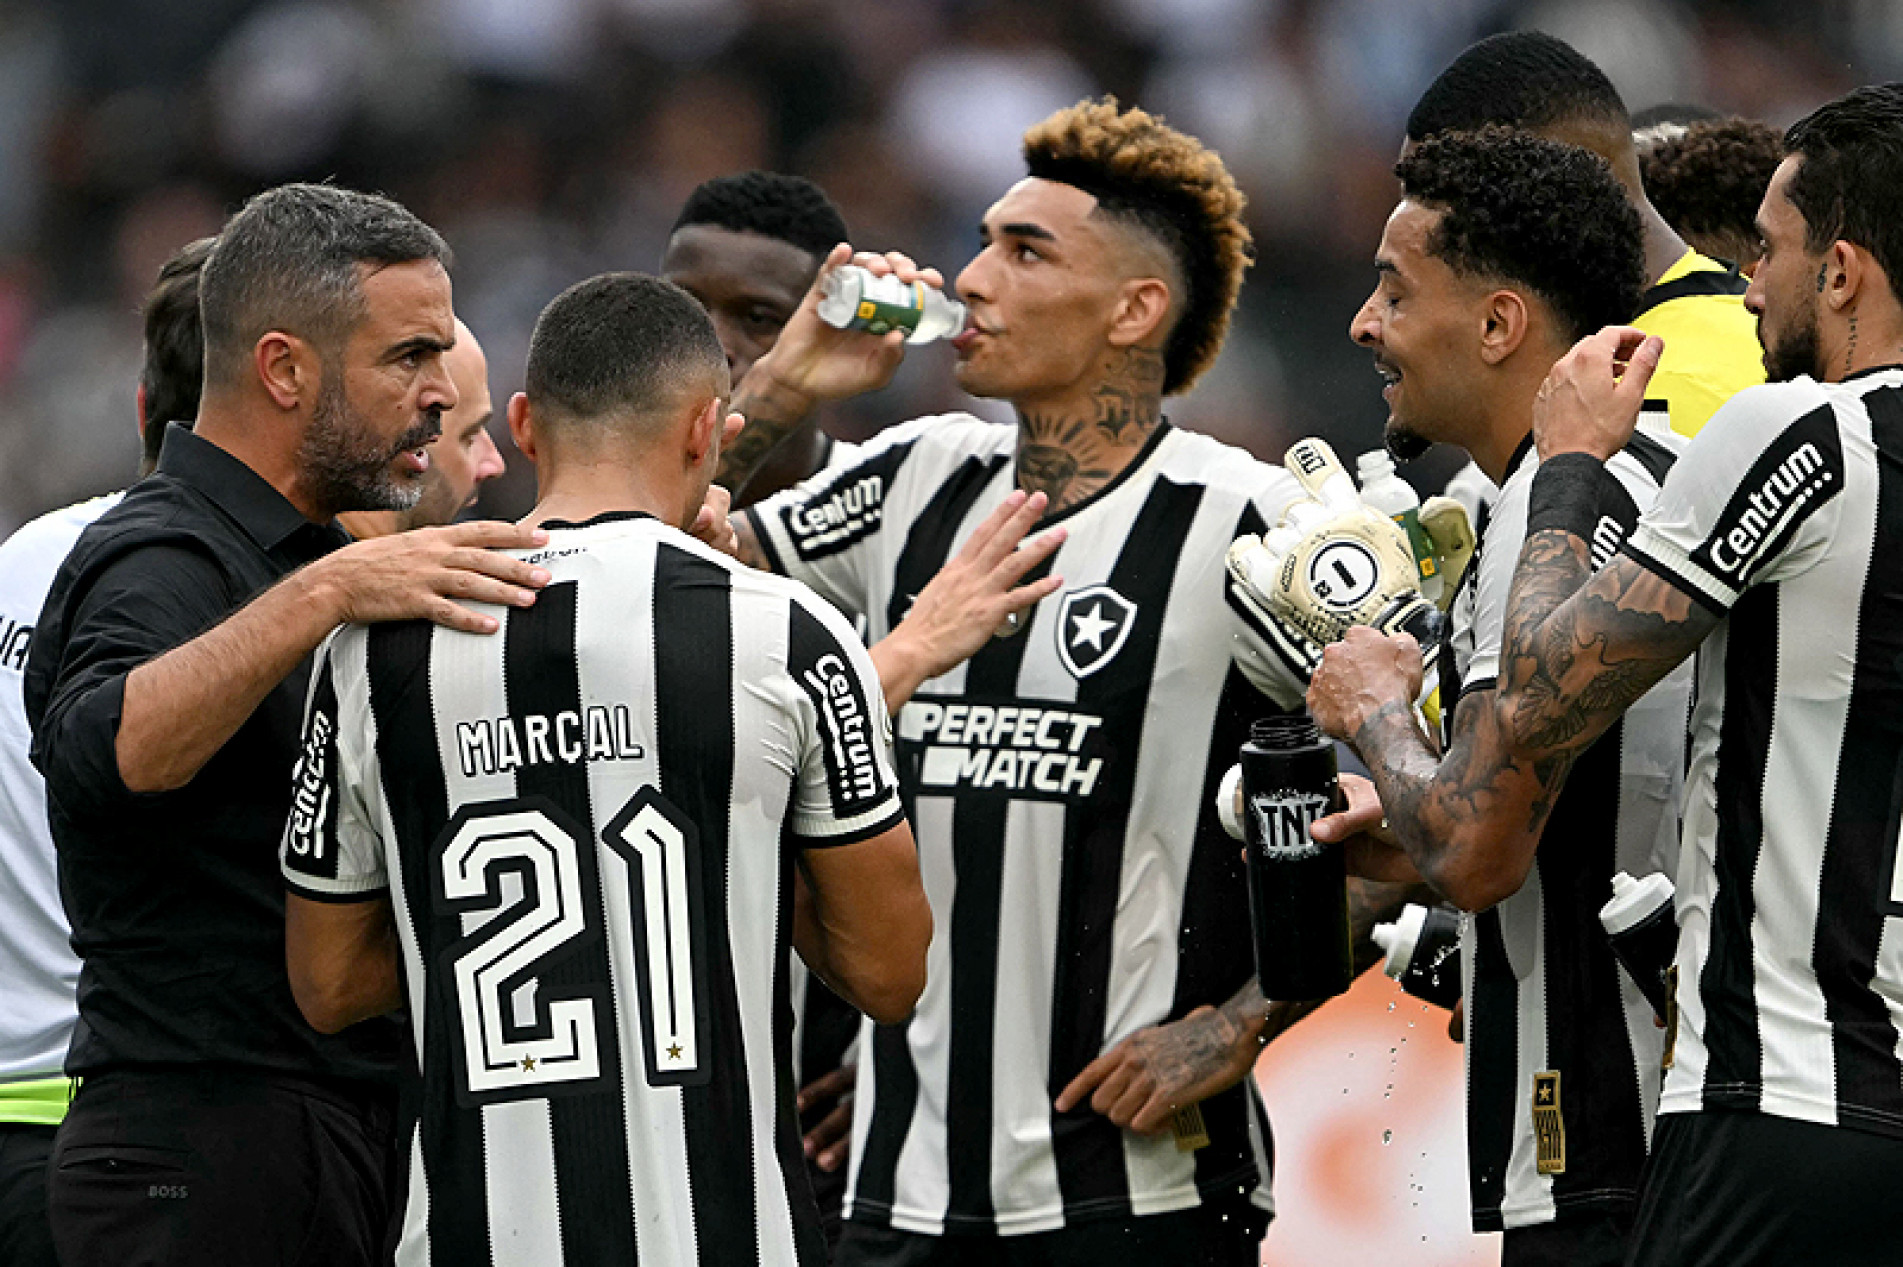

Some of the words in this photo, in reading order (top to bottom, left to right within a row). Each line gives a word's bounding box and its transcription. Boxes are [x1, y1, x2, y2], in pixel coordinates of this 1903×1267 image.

[1709, 441, 1825, 573] Centrum
[457, 705, 643, 776] MARÇAL
[816, 653, 876, 799] Centrum
[900, 701, 1103, 752] PERFECT
[921, 745, 1103, 796] MATCH
[441, 803, 699, 1092] 21
